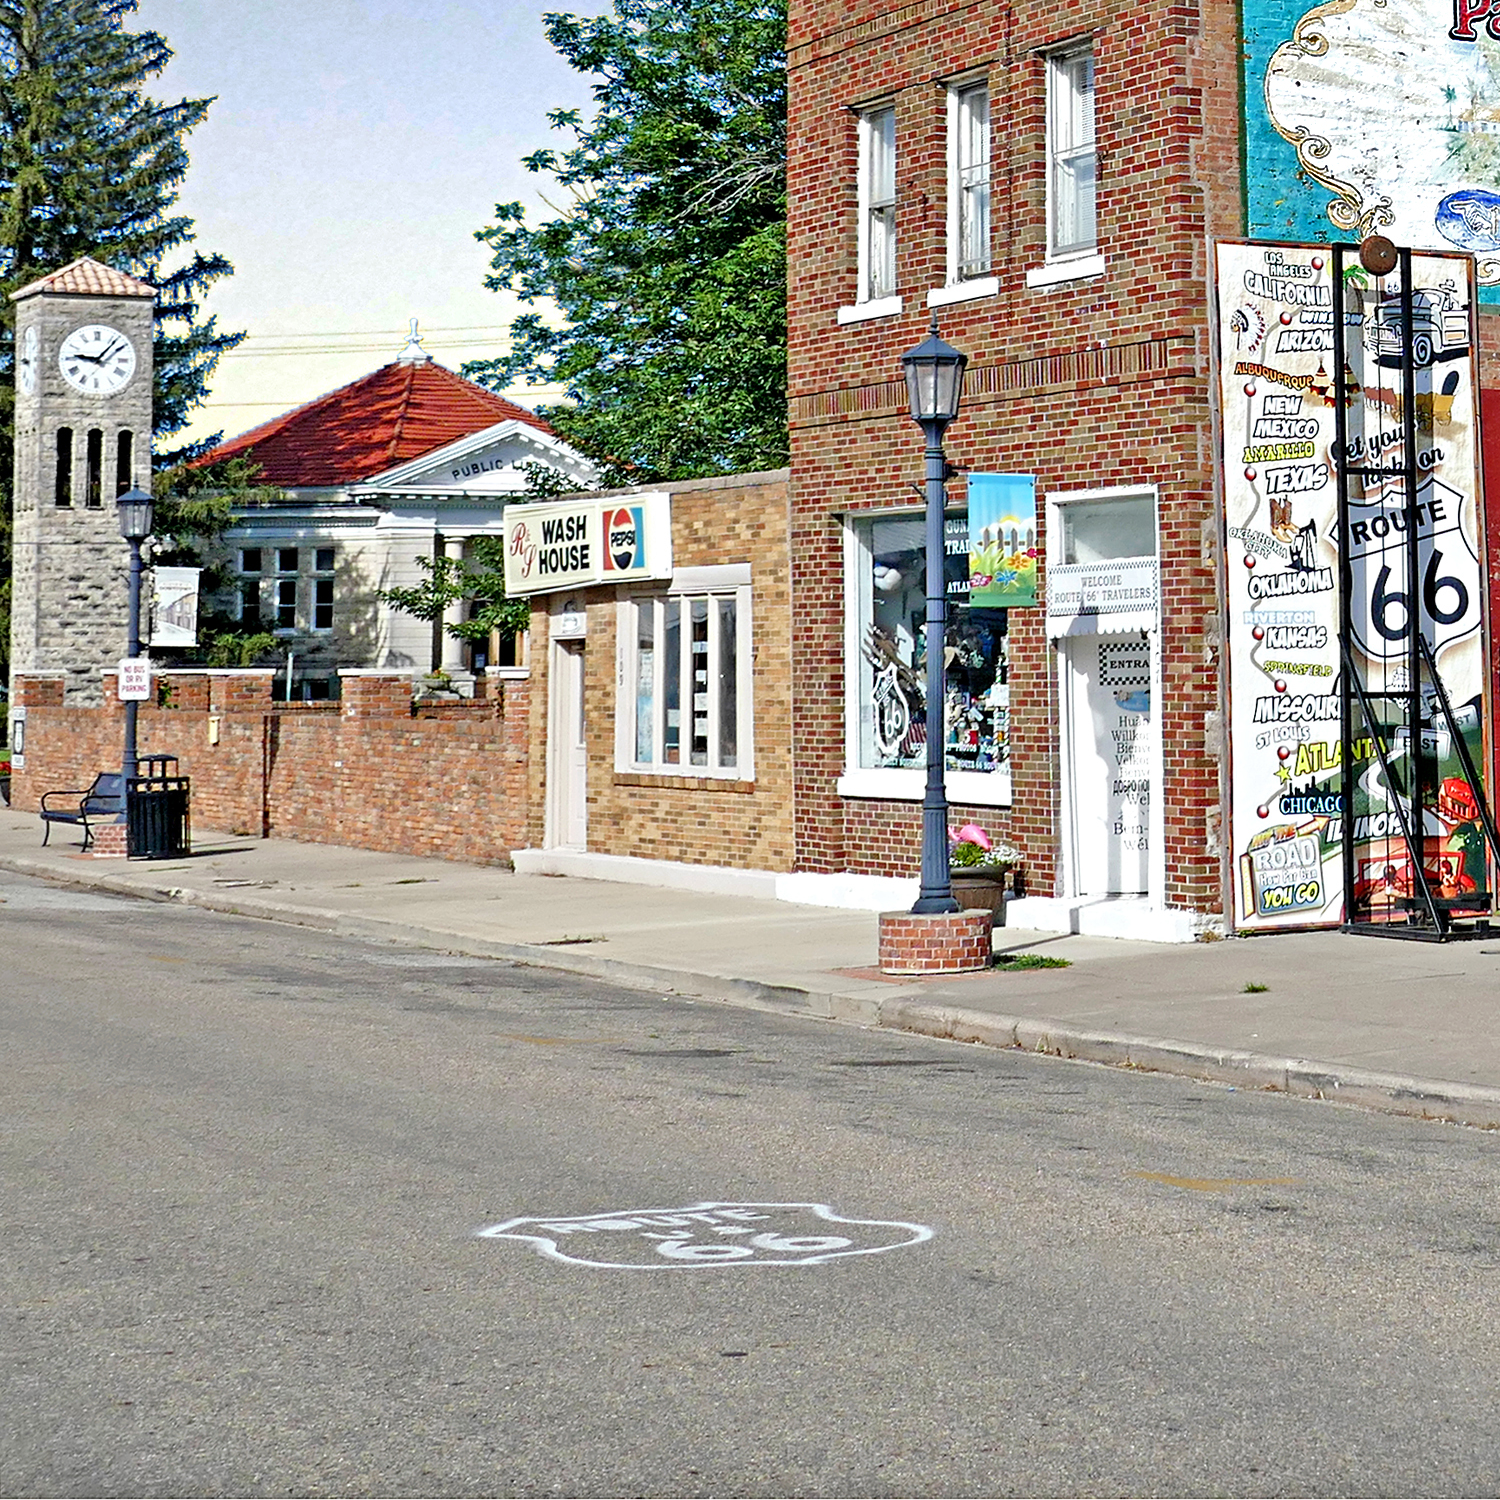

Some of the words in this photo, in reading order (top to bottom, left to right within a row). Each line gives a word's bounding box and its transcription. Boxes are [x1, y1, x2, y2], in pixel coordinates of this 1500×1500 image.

[1264, 251, 1282, 265] LOS
[1270, 264, 1312, 278] ANGELES
[1244, 269, 1331, 306] CALIFORNIA
[1263, 395, 1303, 417] NEW
[1253, 418, 1319, 439] MEXICO
[1242, 441, 1315, 464] AMARILLO
[1419, 448, 1445, 468] on
[452, 459, 504, 480] PUBLIC
[1265, 464, 1329, 495] TEXAS
[541, 515, 588, 545] WASH
[1350, 499, 1447, 546] ROUTE
[610, 530, 637, 548] PEPSI
[1229, 527, 1288, 559] OKLAHOMA
[1244, 540, 1272, 560] CITY
[538, 545, 590, 575] HOUSE
[1081, 575, 1122, 588] WELCOME
[1248, 567, 1334, 600] OKLAHOMA
[1055, 591, 1081, 603] ROUTE
[1102, 587, 1151, 601] TRAVELERS
[1371, 549, 1469, 641] 66
[1243, 611, 1315, 625] RIVERTON
[1266, 626, 1327, 649] KANSAS
[124, 665, 132, 674] NO
[133, 665, 145, 674] BUS
[1263, 660, 1333, 677] SPRINGFIELD
[121, 683, 147, 692] PARKING
[884, 699, 901, 739] 66
[1437, 713, 1471, 731] WST
[1255, 731, 1271, 750] ST
[1273, 725, 1311, 741] LOUIS
[1403, 737, 1439, 750] EST
[1256, 838, 1317, 871] ROAD
[1262, 884, 1295, 909] YOU
[1295, 881, 1320, 905] GO
[538, 1208, 772, 1234] ROUTE
[656, 1232, 853, 1260] 66
